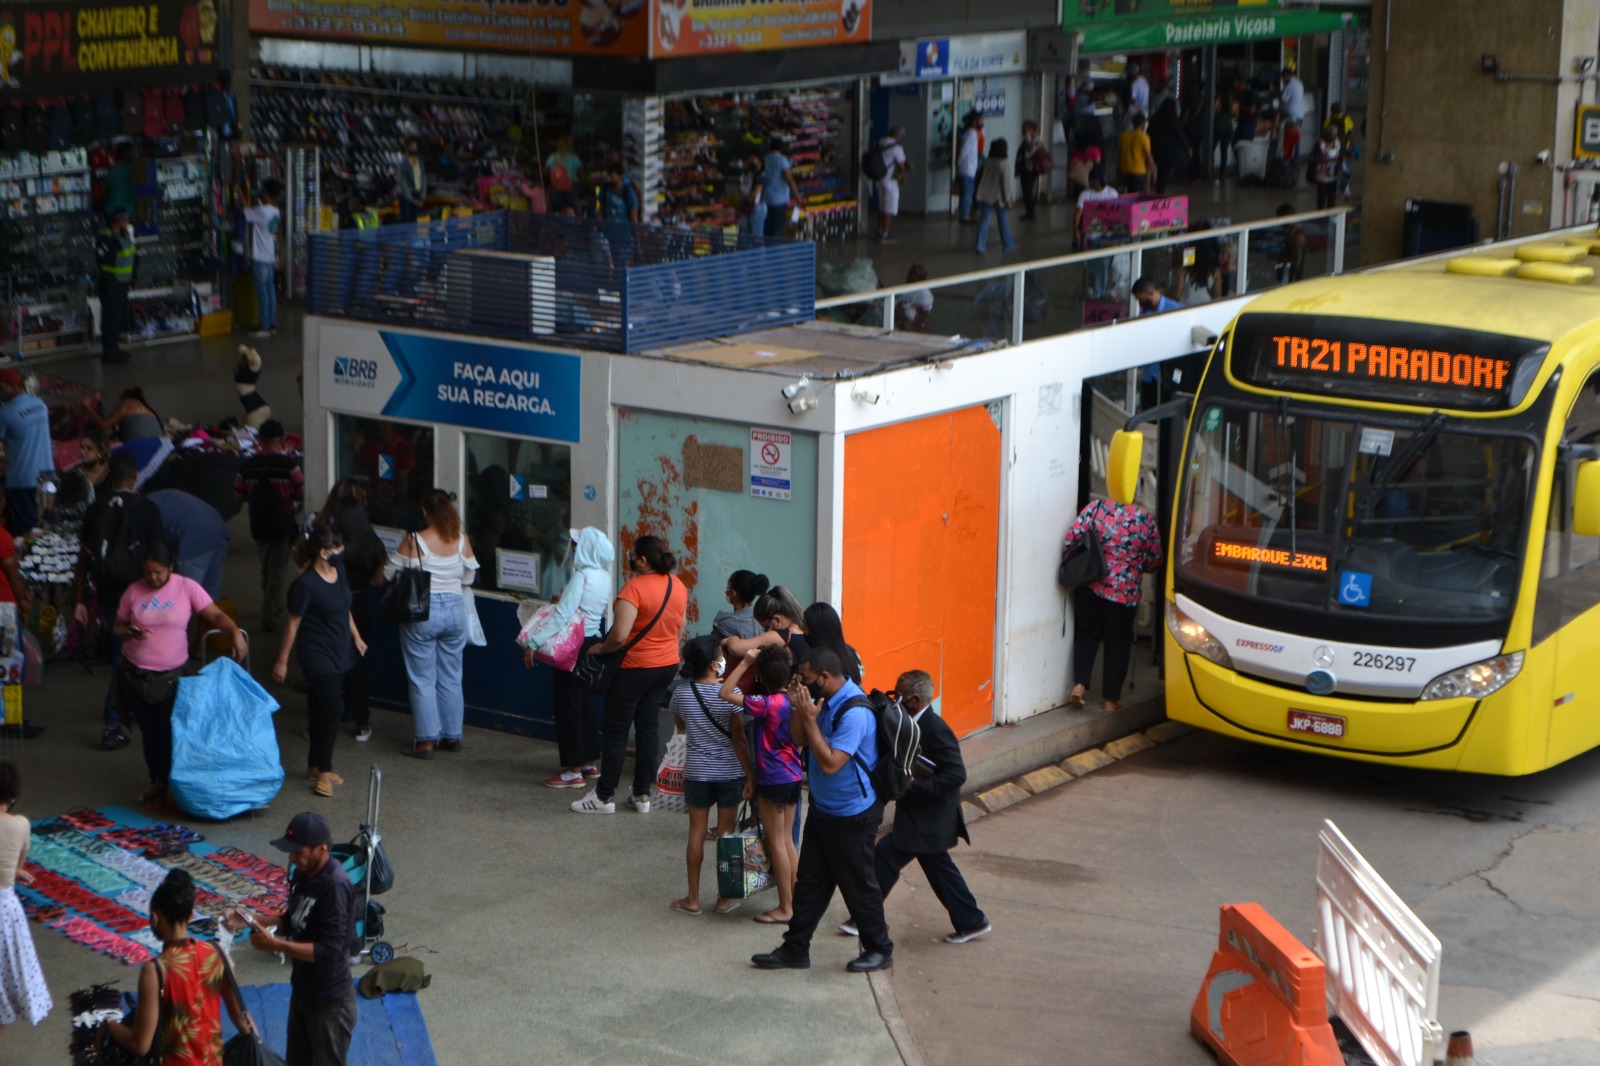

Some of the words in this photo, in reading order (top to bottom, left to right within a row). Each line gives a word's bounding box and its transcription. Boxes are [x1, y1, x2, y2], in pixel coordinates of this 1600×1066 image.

[77, 6, 147, 38] CHAVEIRO
[149, 5, 158, 34] E
[1166, 17, 1231, 44] Pastelaria
[1234, 15, 1276, 39] Viçosa
[1272, 335, 1341, 373] TR21
[334, 376, 376, 389] MOBILIDADE
[349, 358, 378, 381] BRB
[453, 361, 496, 387] FAÇA
[498, 367, 540, 390] AQUI
[437, 384, 470, 405] SUA
[472, 388, 556, 416] RECARGA.
[753, 432, 790, 444] PROIBIDO
[1353, 651, 1417, 673] 226297
[1290, 717, 1343, 736] JKP-6888
